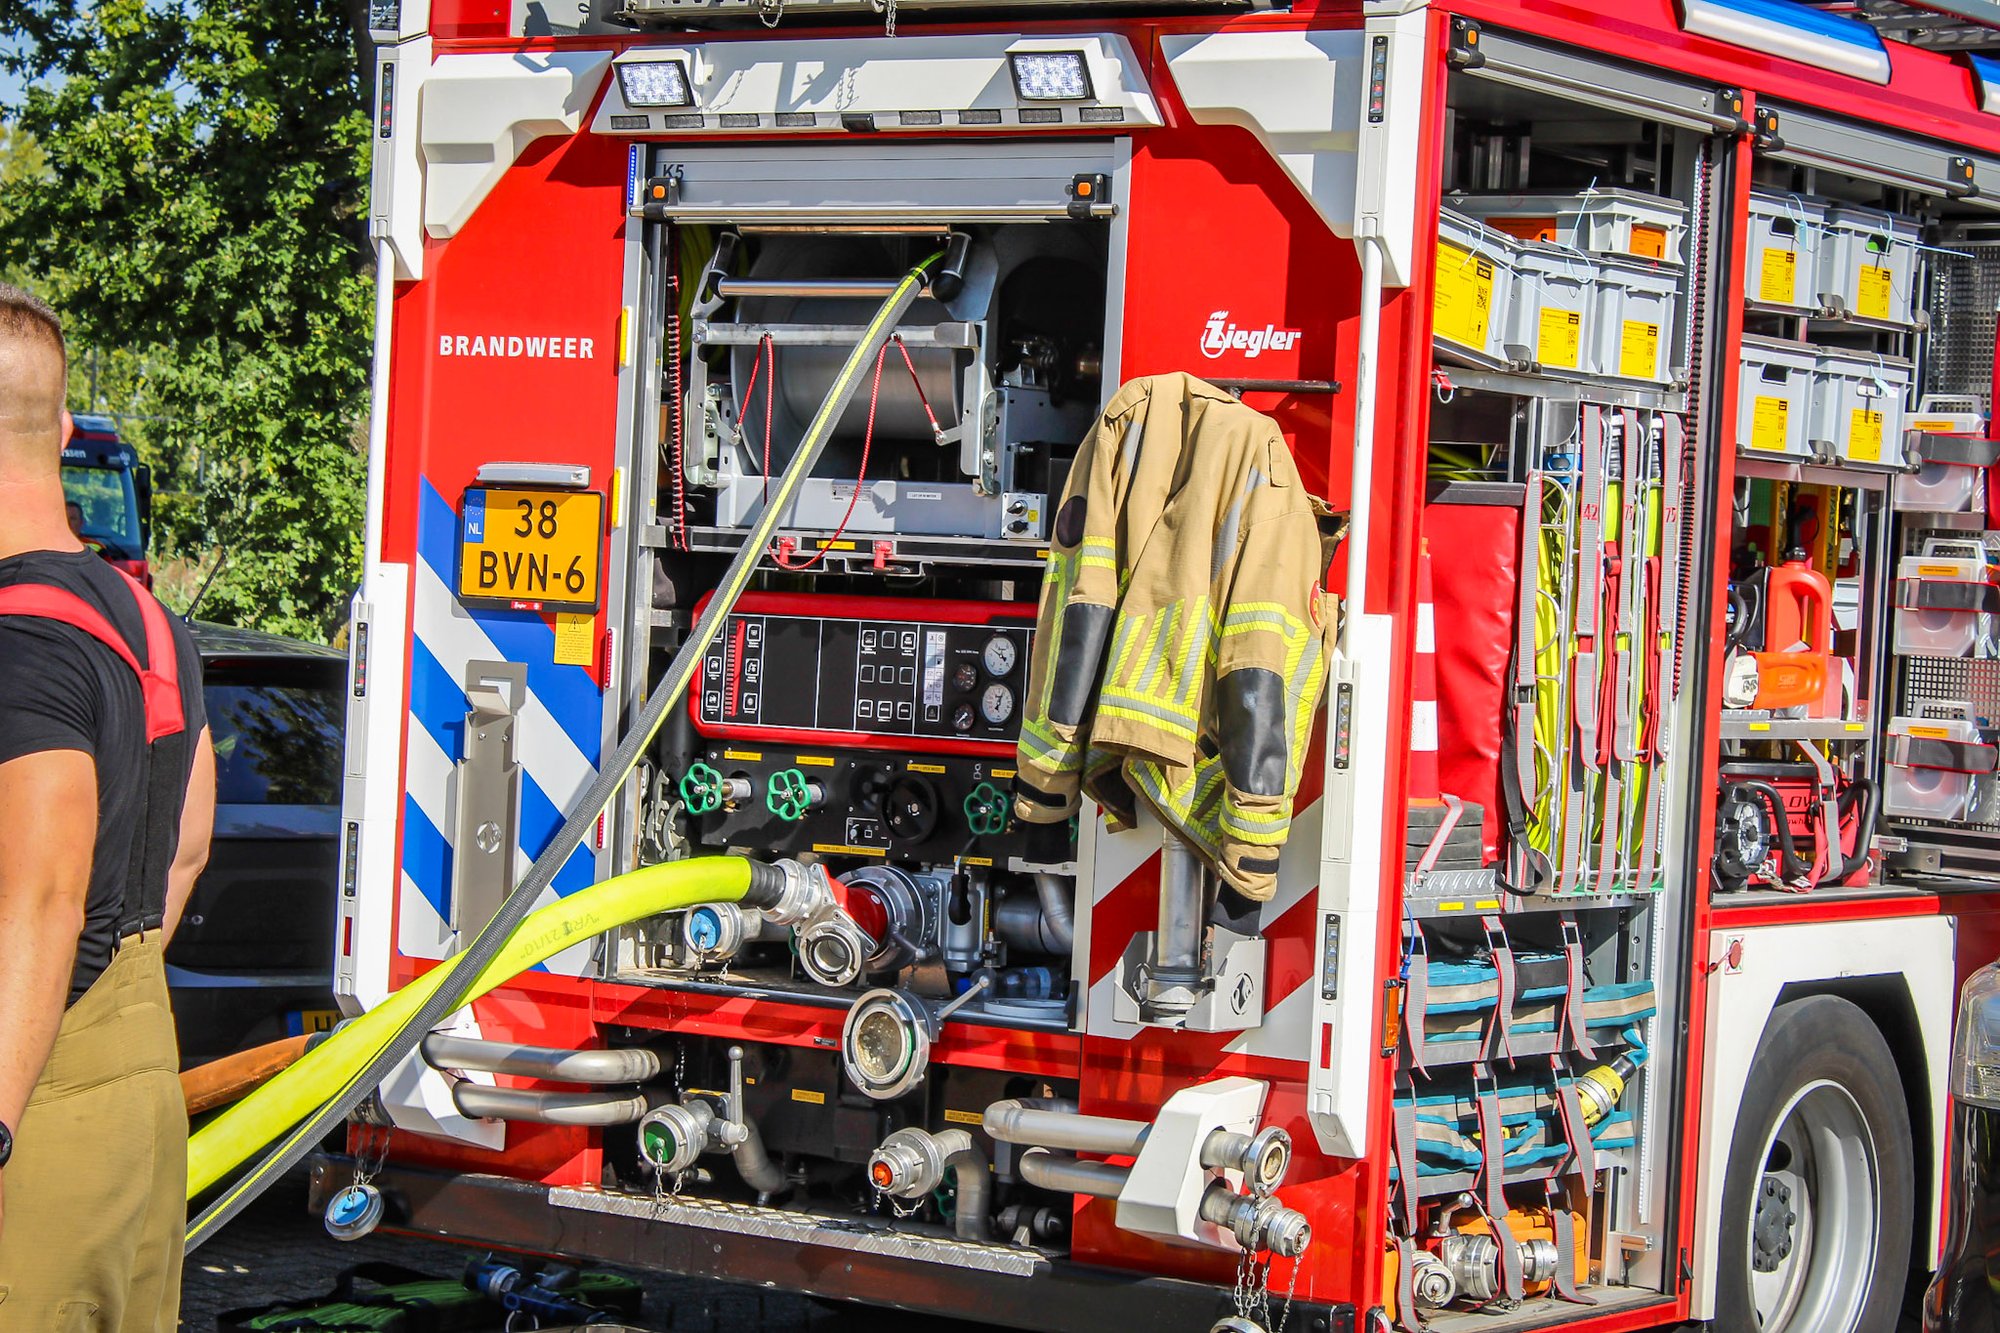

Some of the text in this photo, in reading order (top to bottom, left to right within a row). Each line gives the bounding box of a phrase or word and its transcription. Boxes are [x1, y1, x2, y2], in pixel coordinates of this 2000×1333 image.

[663, 164, 684, 181] K5
[1201, 311, 1302, 358] Ziegler
[439, 335, 594, 359] BRANDWEER
[514, 499, 558, 539] 38
[1583, 504, 1598, 520] 42
[468, 522, 482, 535] NL
[479, 550, 585, 594] BVN-6
